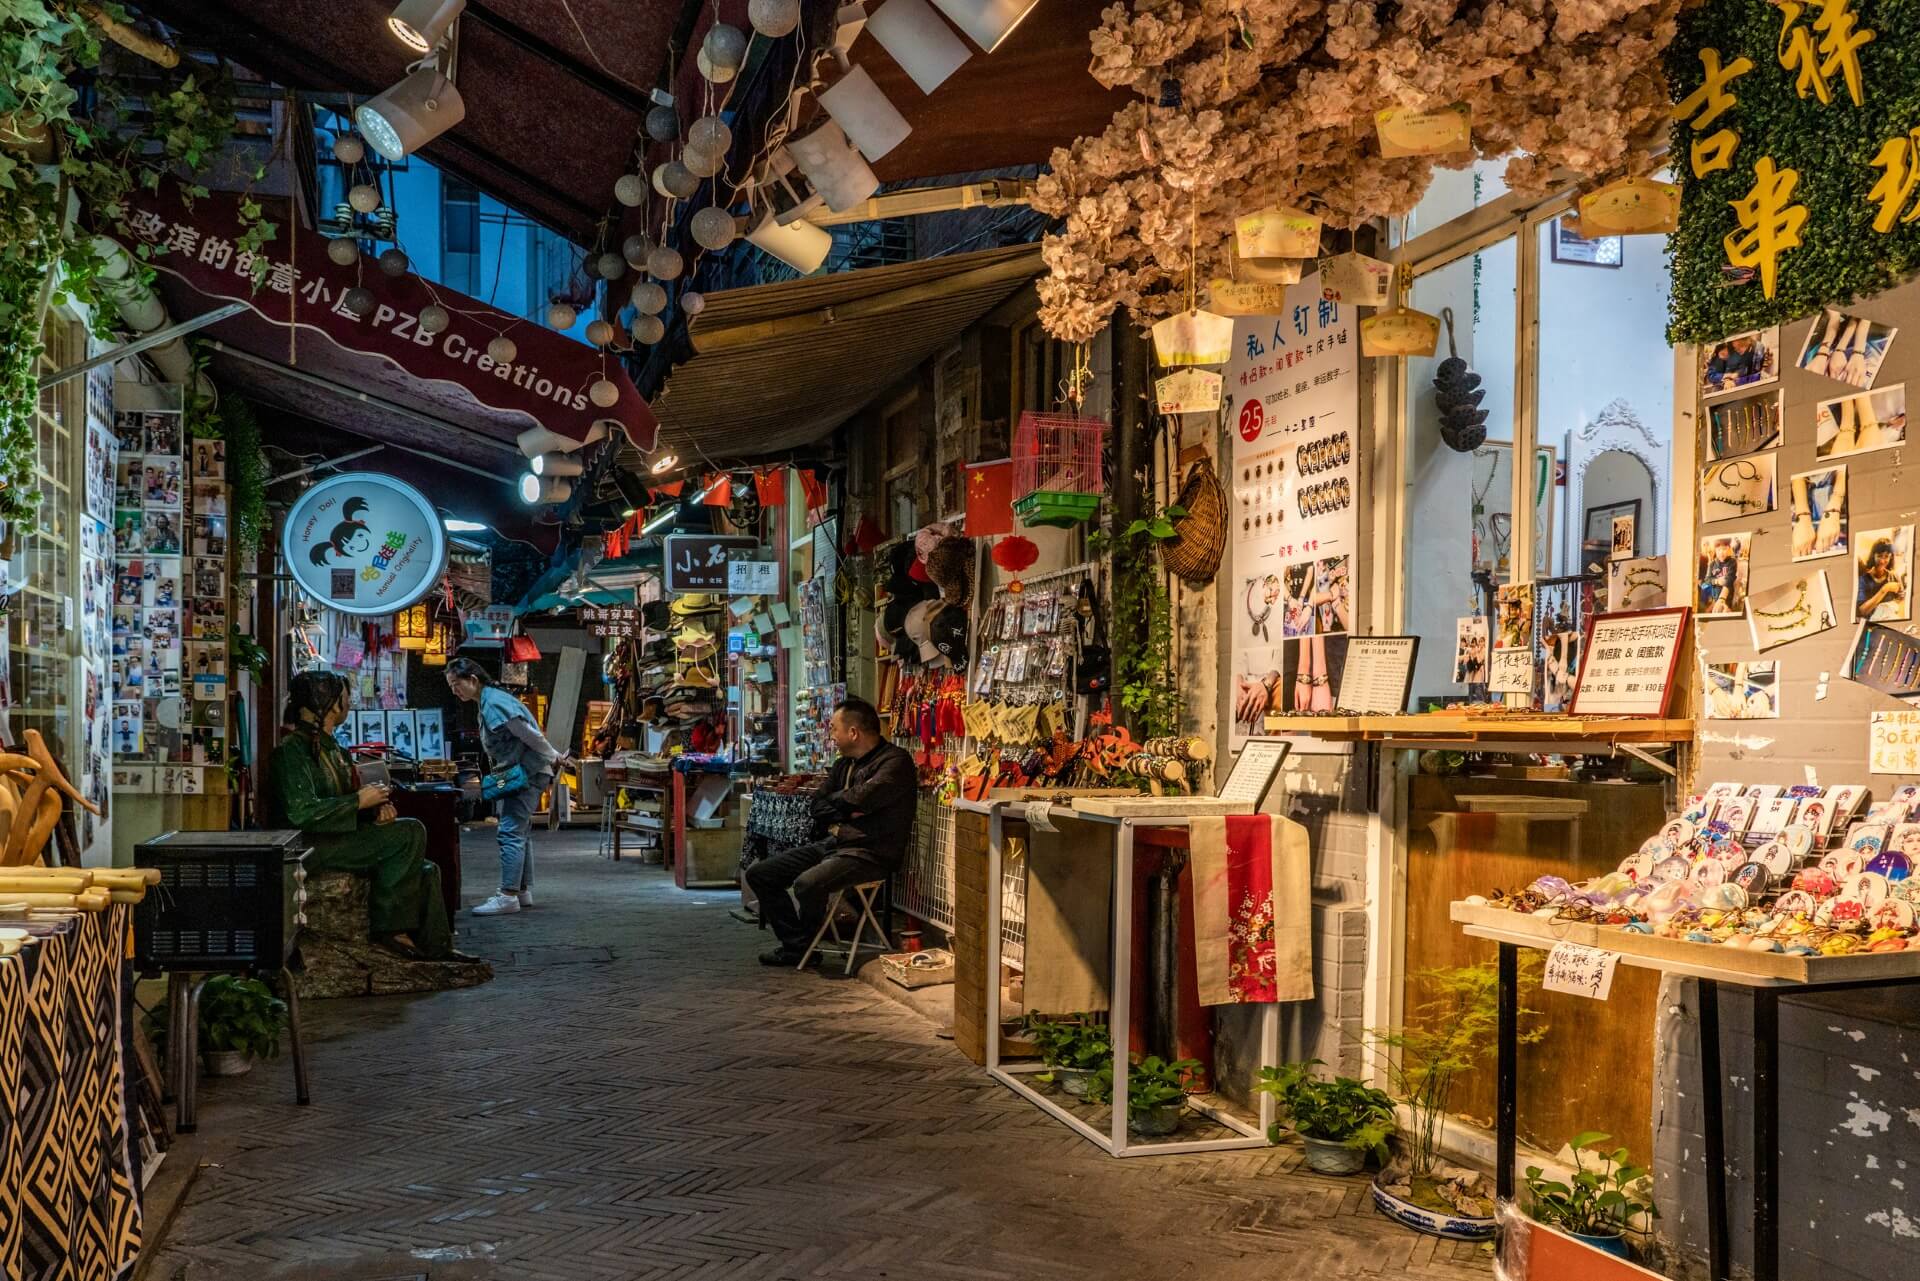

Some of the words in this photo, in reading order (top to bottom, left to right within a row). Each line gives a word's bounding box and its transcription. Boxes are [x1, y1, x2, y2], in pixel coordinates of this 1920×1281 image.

[372, 303, 435, 347] PZB
[443, 333, 589, 411] Creations
[1242, 405, 1262, 434] 25
[303, 515, 318, 542] Honey
[376, 572, 397, 597] Manual
[595, 625, 633, 637] 改耳夹
[1596, 648, 1622, 660] 情侣款
[1625, 648, 1633, 658] &
[1636, 645, 1665, 658] 闺蜜款
